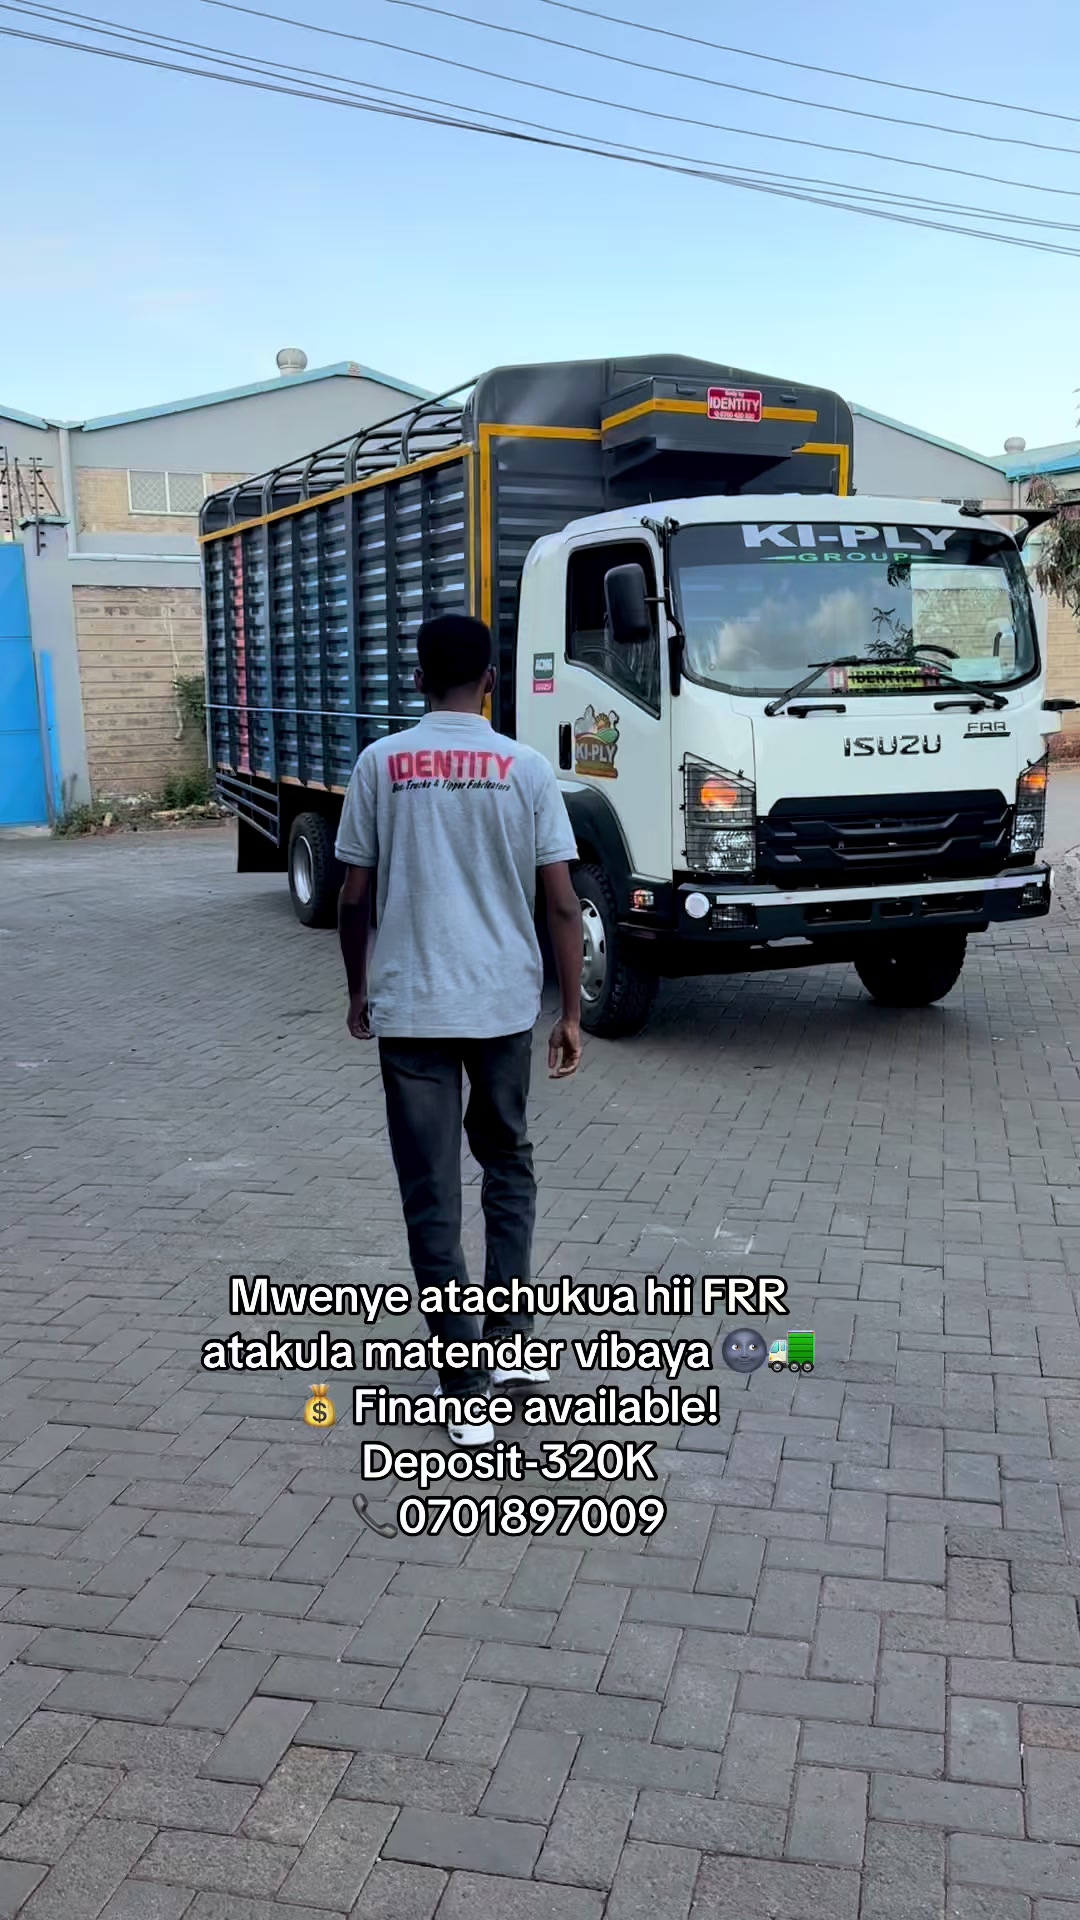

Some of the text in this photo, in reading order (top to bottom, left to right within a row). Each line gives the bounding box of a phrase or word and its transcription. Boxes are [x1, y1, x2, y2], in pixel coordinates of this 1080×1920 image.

[710, 396, 760, 412] IDENTITY
[741, 524, 956, 550] KI-PLY
[800, 552, 908, 562] GROUP
[967, 721, 1006, 732] FRR
[576, 743, 616, 763] KI-PLY
[843, 734, 941, 757] ISUZU
[387, 750, 514, 782] IDENTITY
[406, 780, 431, 790] Trucks
[442, 780, 465, 791] Tipper
[467, 780, 511, 791] Fabricators
